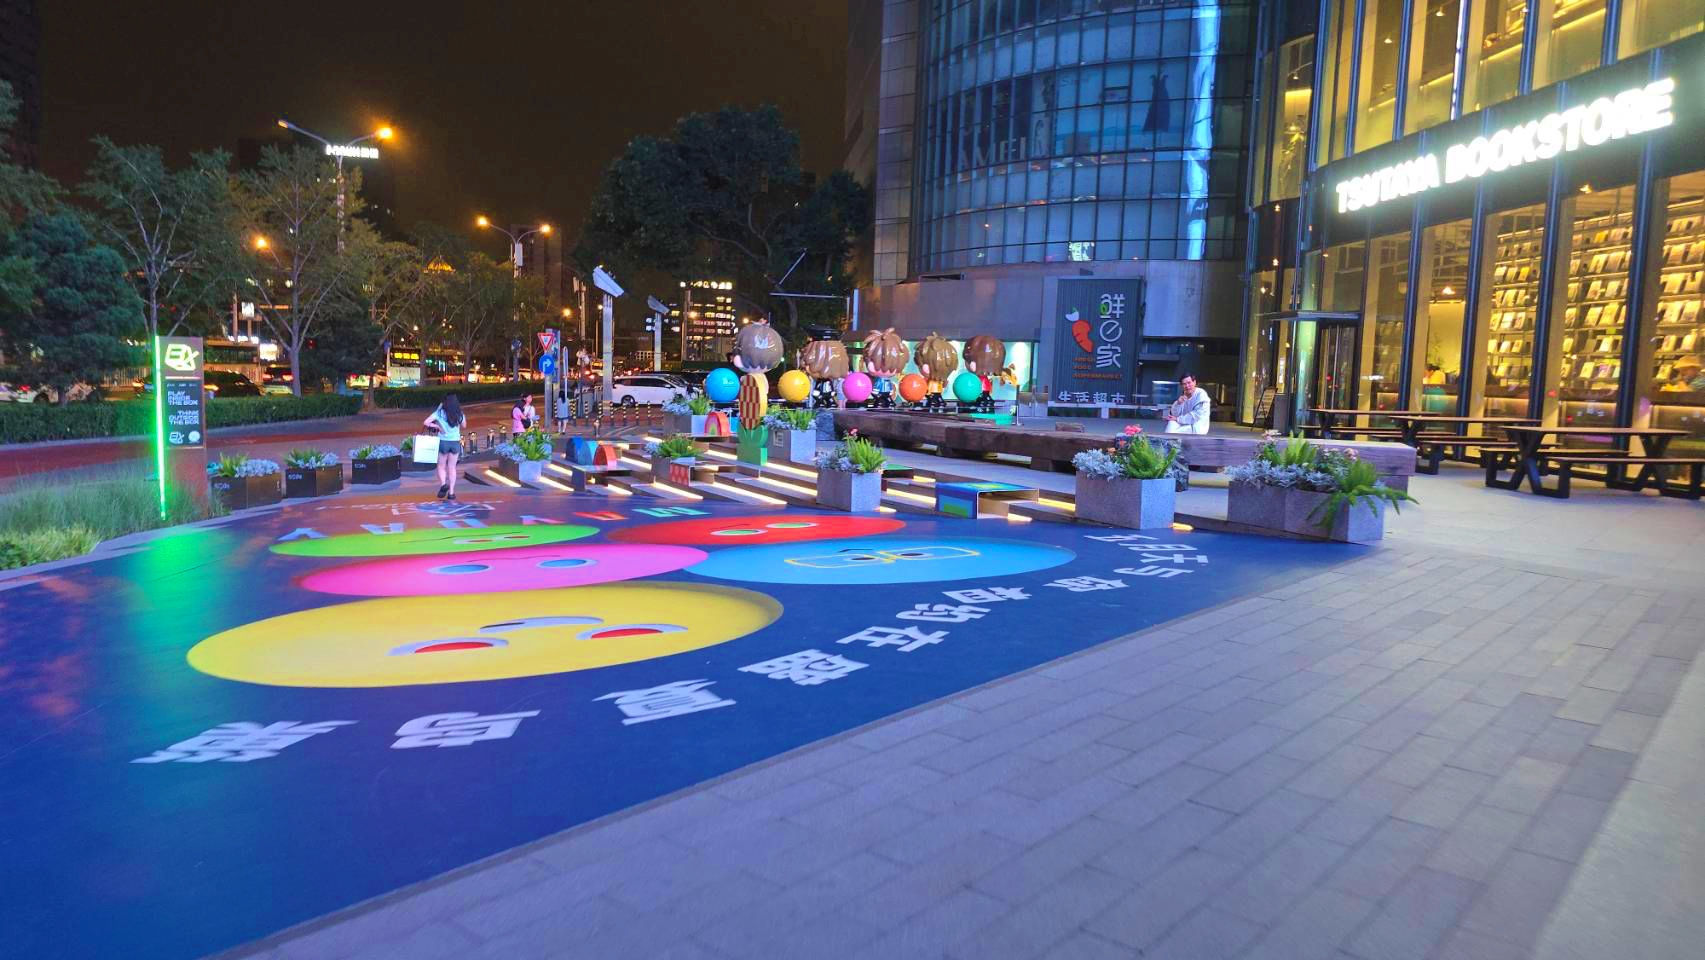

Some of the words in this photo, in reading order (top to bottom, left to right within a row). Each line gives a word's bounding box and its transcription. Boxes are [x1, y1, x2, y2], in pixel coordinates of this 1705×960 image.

[1336, 153, 1440, 213] TSUTAYA
[1445, 78, 1675, 183] BOOKSTORE
[1058, 391, 1126, 403] 生活超市
